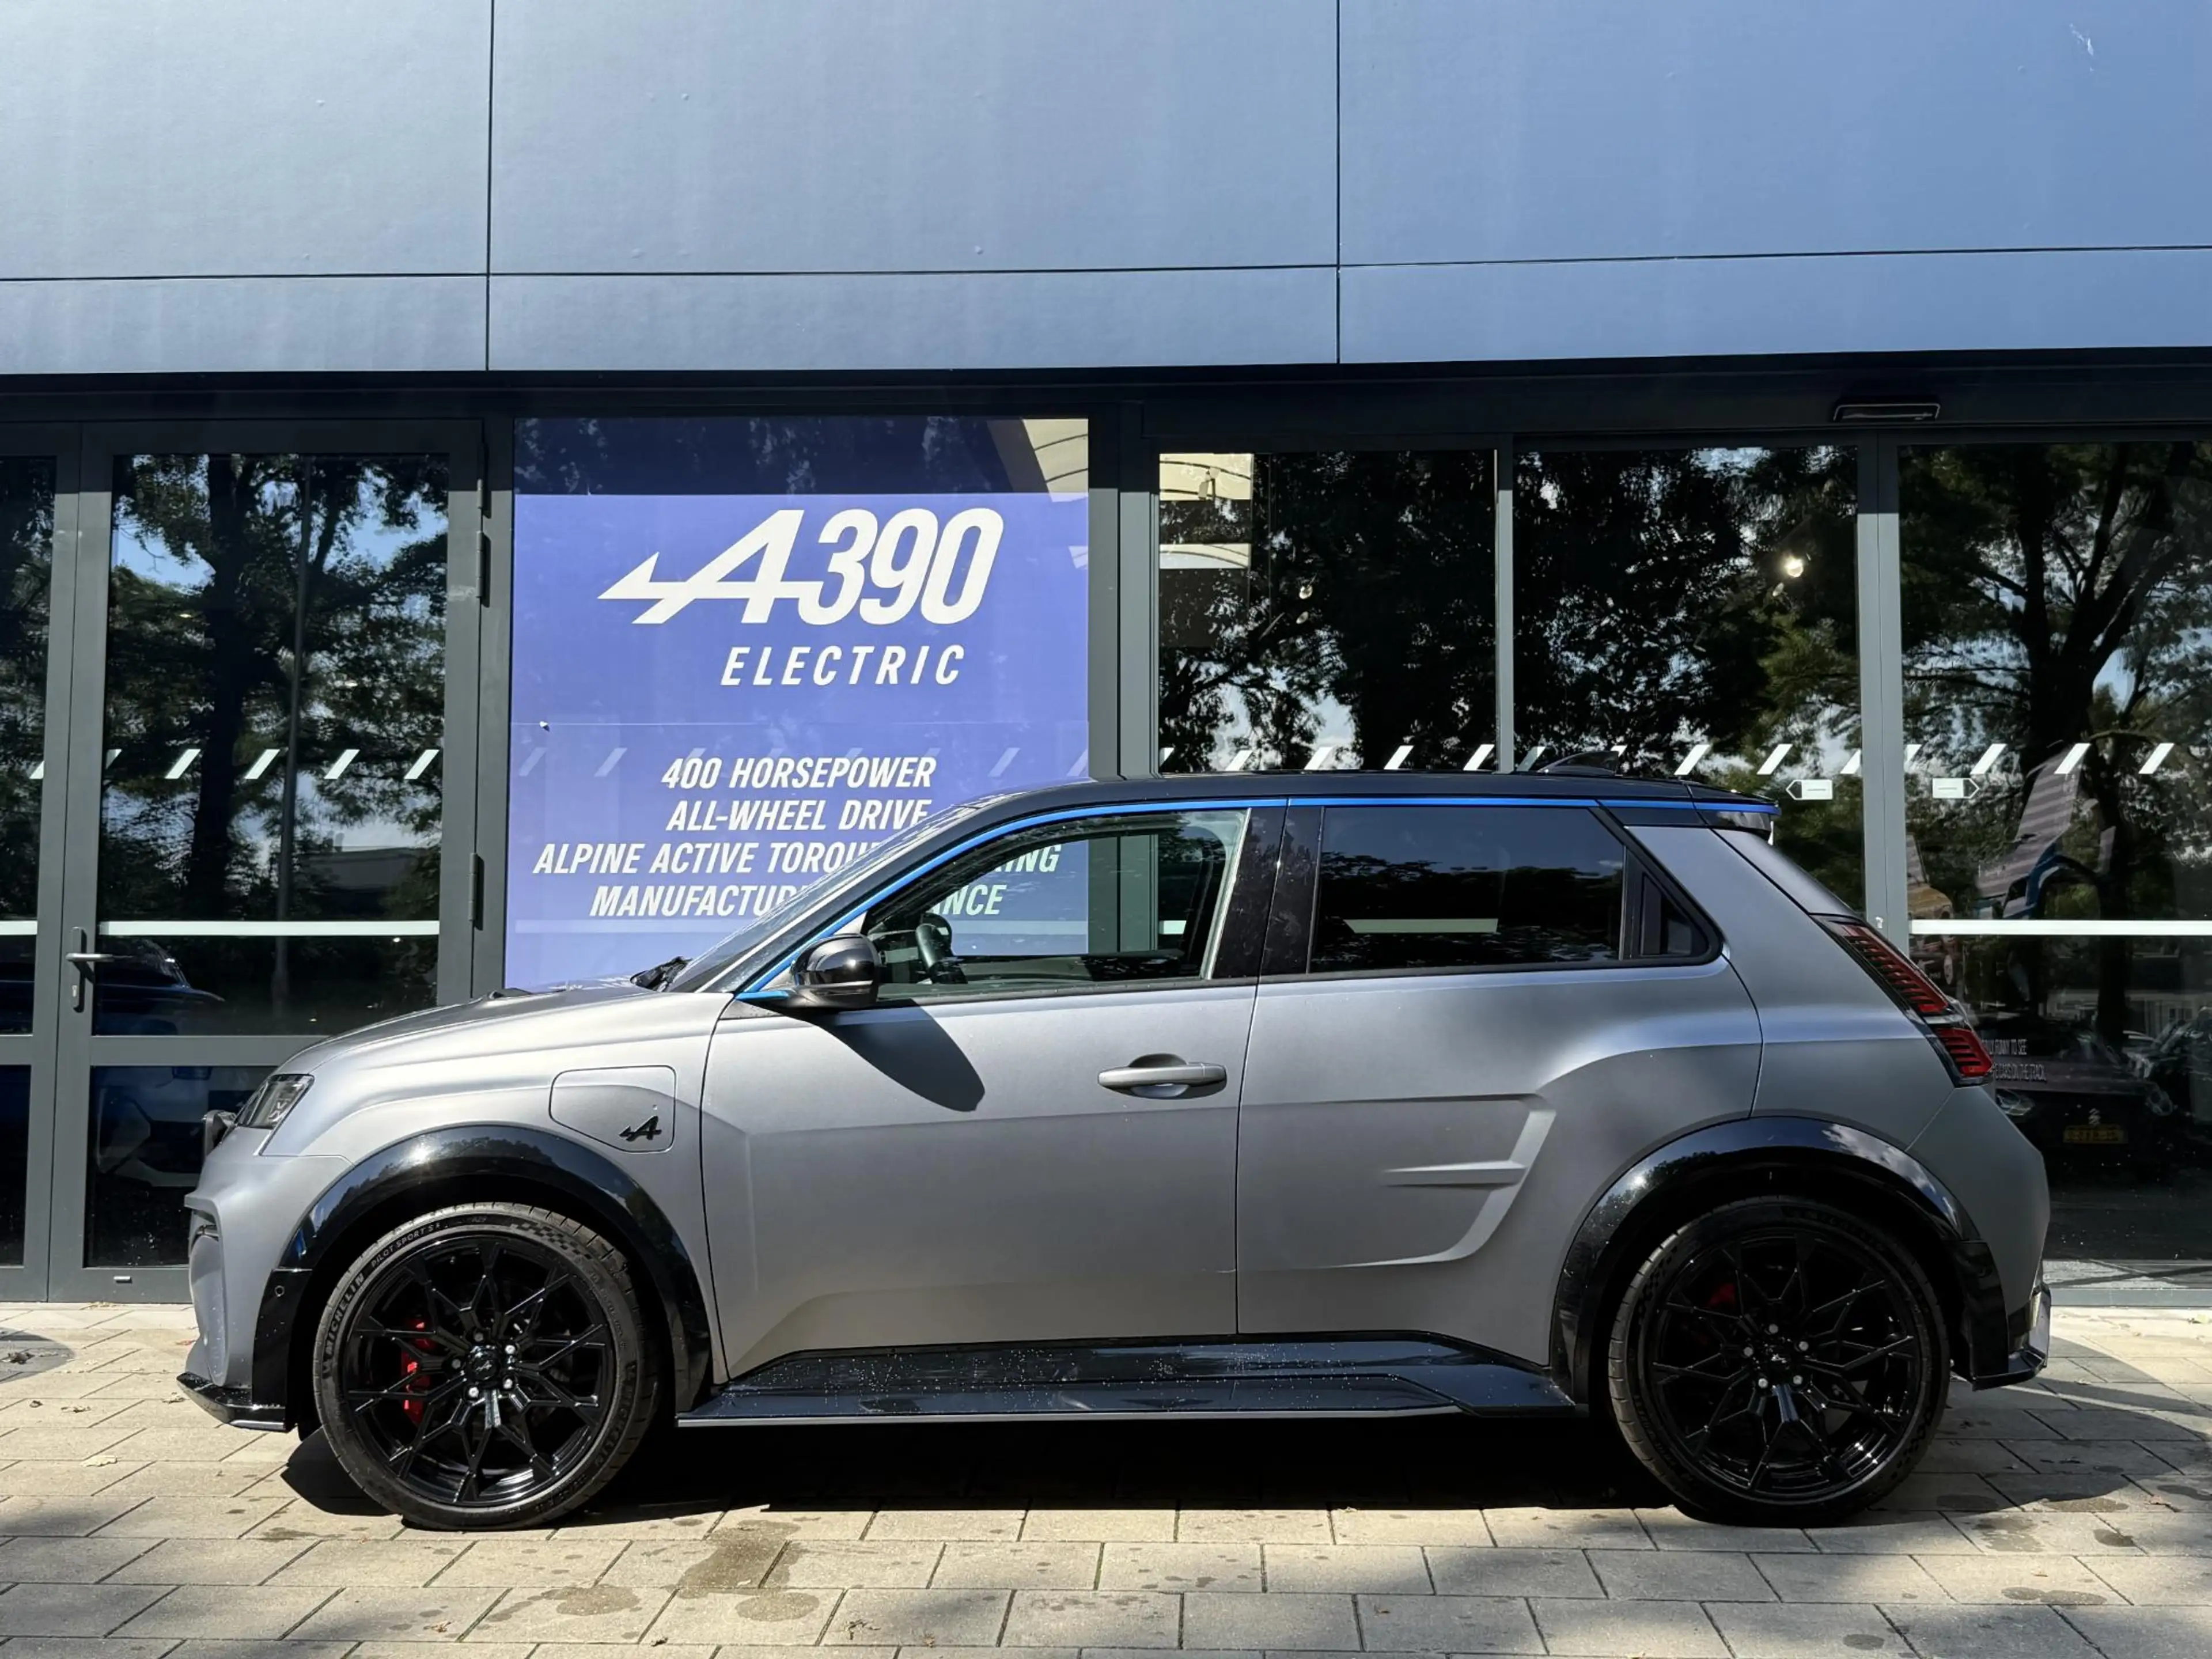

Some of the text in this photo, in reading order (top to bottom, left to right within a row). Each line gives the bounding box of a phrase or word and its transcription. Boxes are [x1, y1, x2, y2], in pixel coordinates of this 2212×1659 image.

[597, 507, 1004, 625] A390
[720, 644, 965, 685] ELECTRIC
[661, 756, 937, 789] 400 HORSEPOWER
[665, 799, 933, 831] ALL-WHEEL DRIVE
[532, 843, 645, 874] ALPINE
[649, 842, 759, 874] ACTIVE
[370, 1245, 394, 1268] PILOT
[396, 1229, 426, 1248] SPORT
[325, 1272, 365, 1355] MICHELIN
